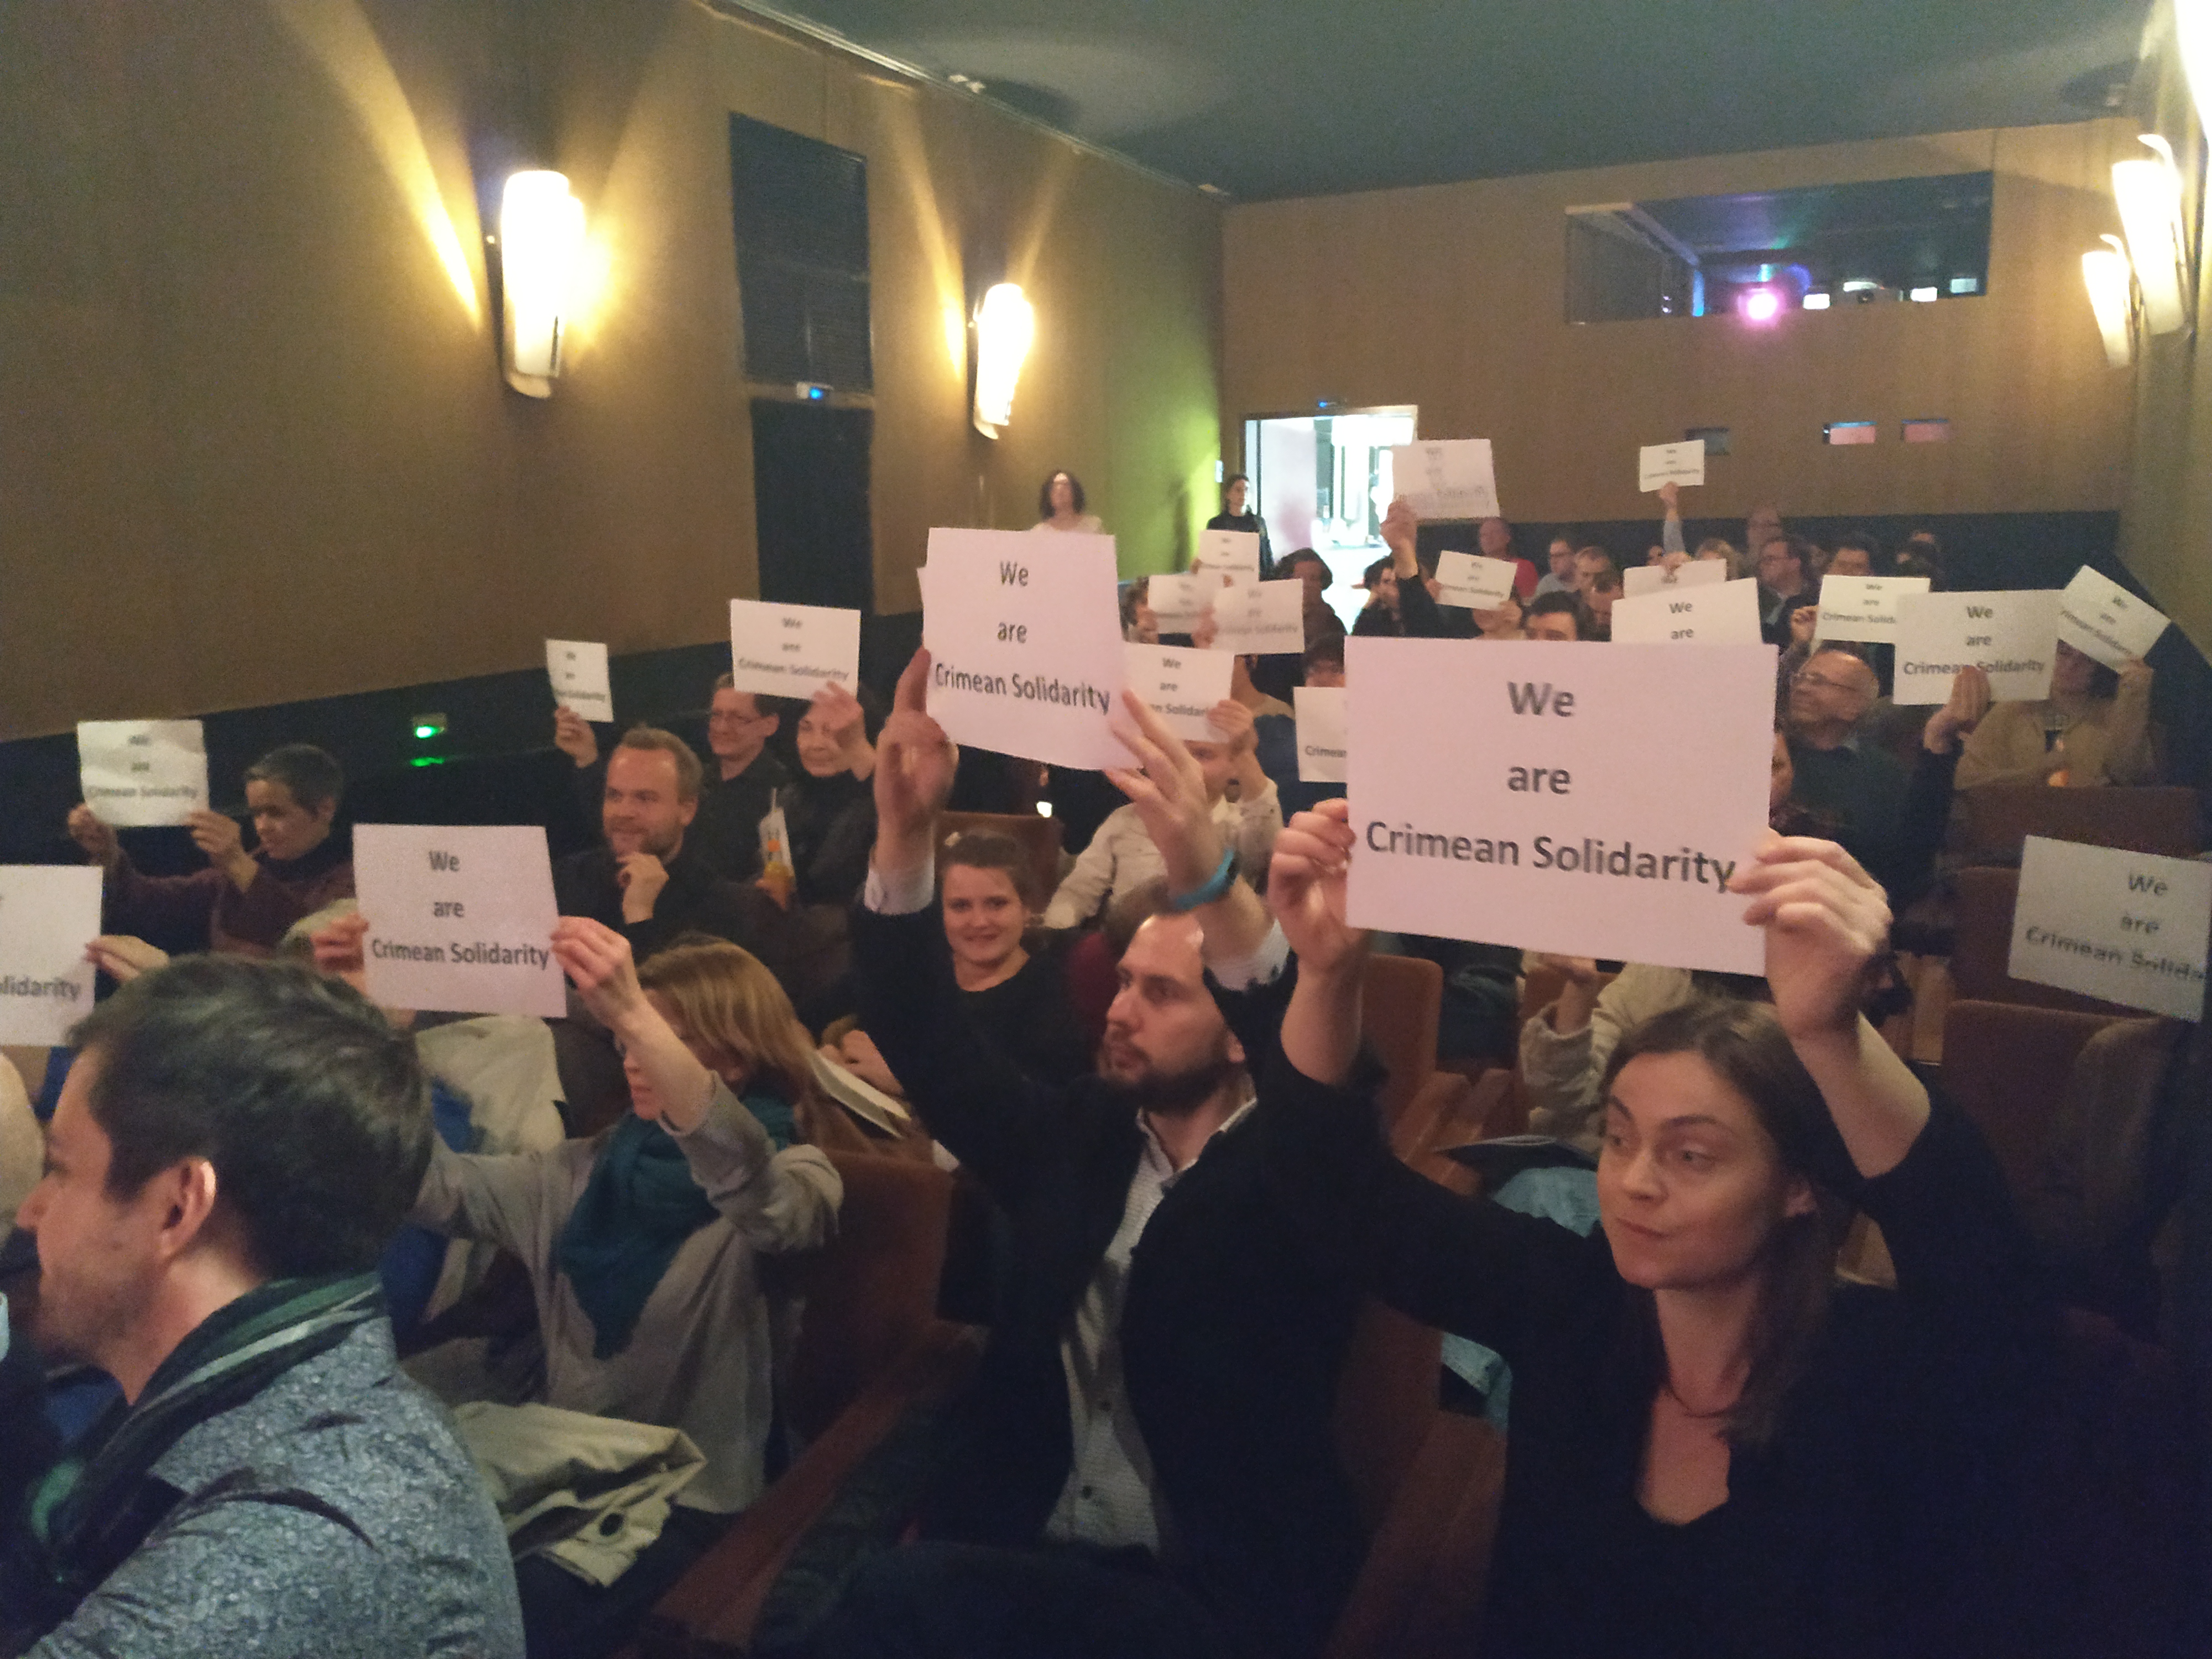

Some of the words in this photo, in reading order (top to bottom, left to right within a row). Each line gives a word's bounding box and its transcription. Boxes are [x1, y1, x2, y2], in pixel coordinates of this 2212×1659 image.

[1000, 562, 1029, 587] We
[1669, 602, 1693, 614] We
[1966, 606, 1993, 619] We
[997, 622, 1027, 644] are
[1671, 628, 1694, 640] are
[1966, 635, 1992, 646] are
[1162, 658, 1182, 669] We
[1903, 661, 1967, 675] Crimea
[935, 662, 1007, 695] Crimean
[1011, 673, 1110, 716] Solidarity
[1159, 682, 1178, 692] are
[1507, 682, 1574, 717] We
[1165, 703, 1208, 717] Solidar
[1507, 766, 1571, 795] are
[428, 851, 460, 872] We
[1366, 821, 1519, 866] Crimean
[1532, 836, 1736, 894] Solidarity
[2128, 874, 2168, 896] We
[432, 901, 465, 919] are
[2120, 916, 2160, 935] are
[2025, 925, 2124, 963] Crimean
[371, 938, 446, 962] Crimean
[450, 942, 549, 971] Solidarity
